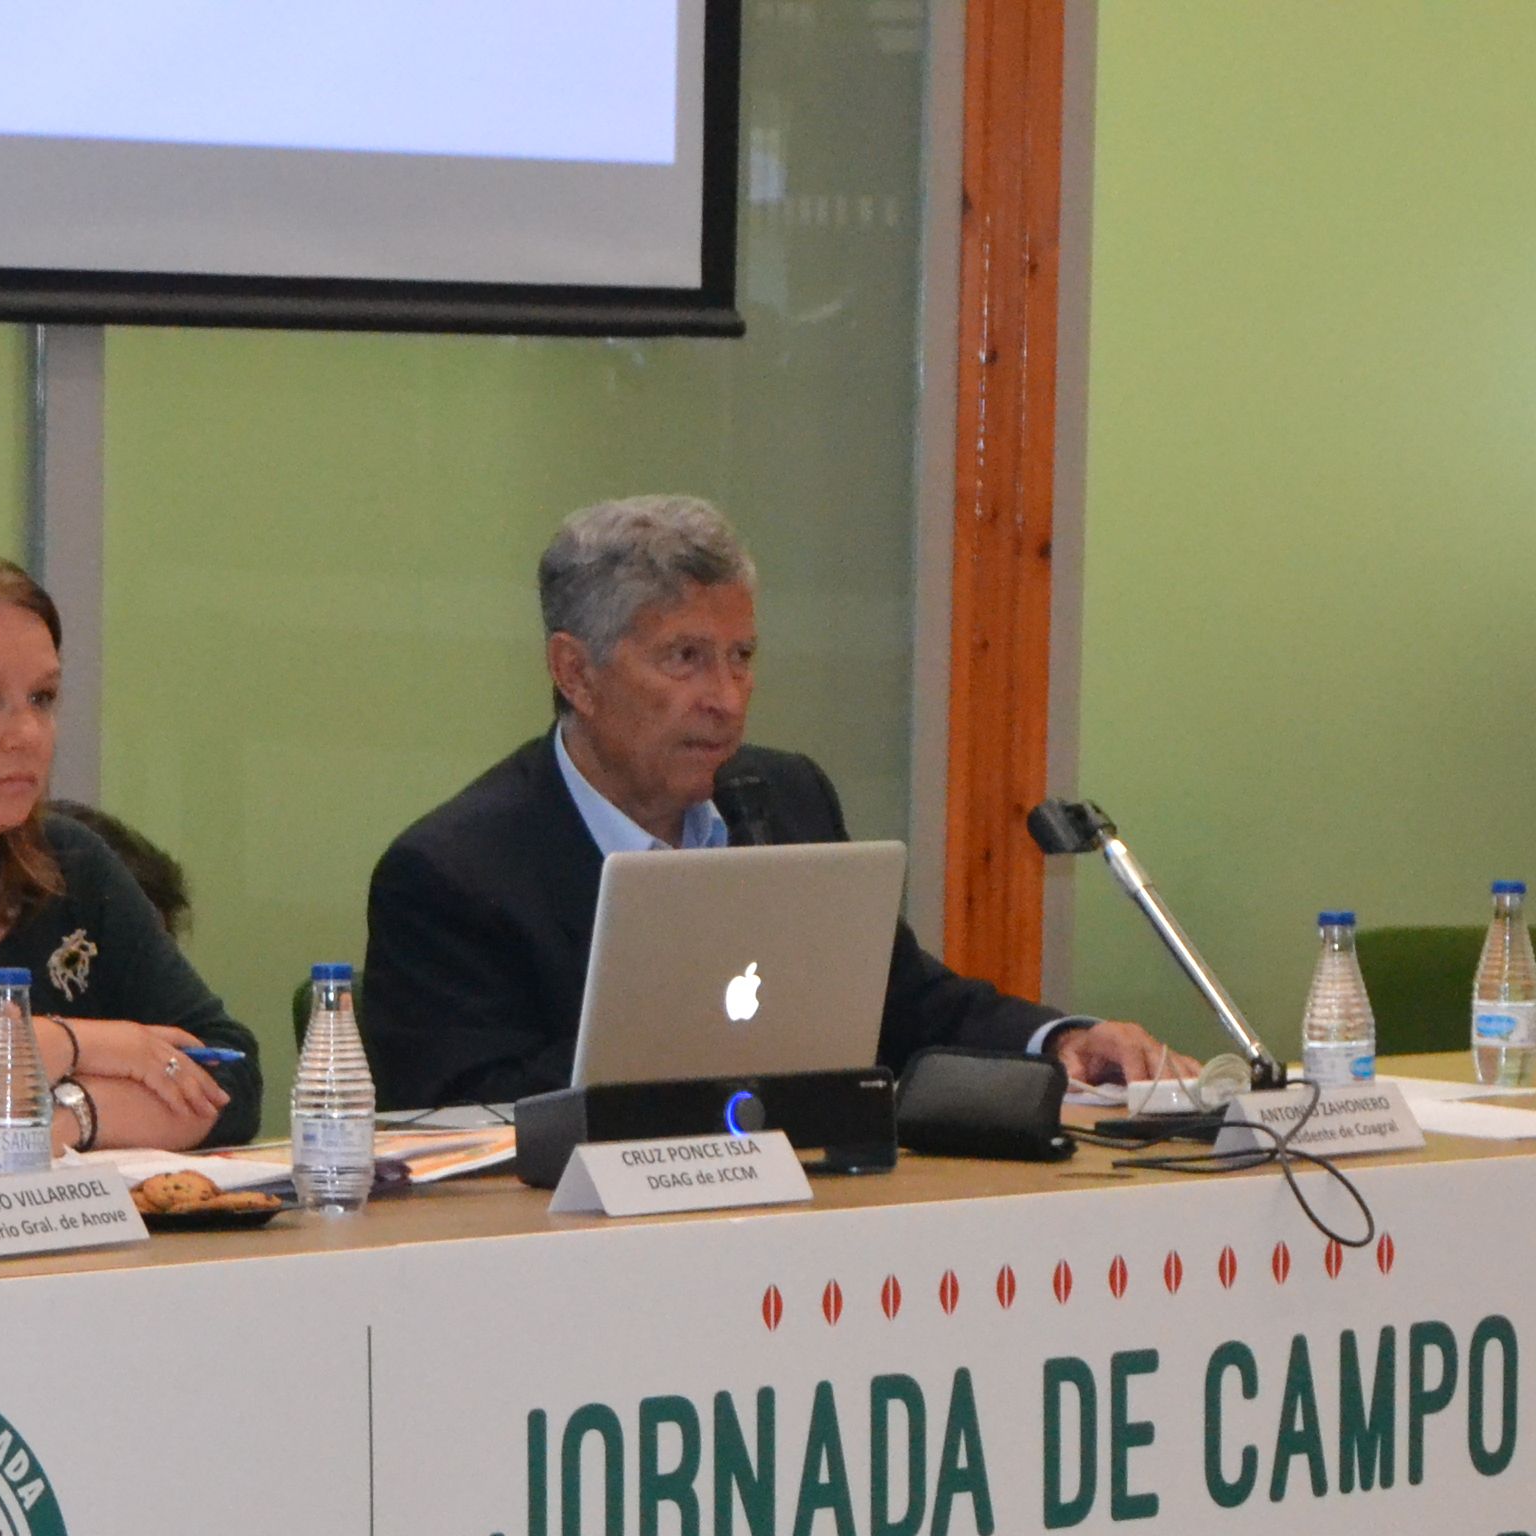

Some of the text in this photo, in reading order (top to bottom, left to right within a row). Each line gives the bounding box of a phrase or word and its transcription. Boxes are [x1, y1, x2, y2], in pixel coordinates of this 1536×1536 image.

[1322, 1096, 1390, 1116] ZAHONERO
[1339, 1125, 1353, 1138] de
[1355, 1119, 1400, 1137] Coagral
[622, 1139, 761, 1167] CRUZ PONCE ISLA
[645, 1165, 758, 1190] DGAG de JCCM
[13, 1179, 110, 1208] VILLARROEL
[21, 1215, 58, 1240] Gral.
[60, 1211, 79, 1231] de
[82, 1207, 128, 1227] Anove
[1043, 1347, 1160, 1530] DE
[1204, 1313, 1519, 1510] CAMPO
